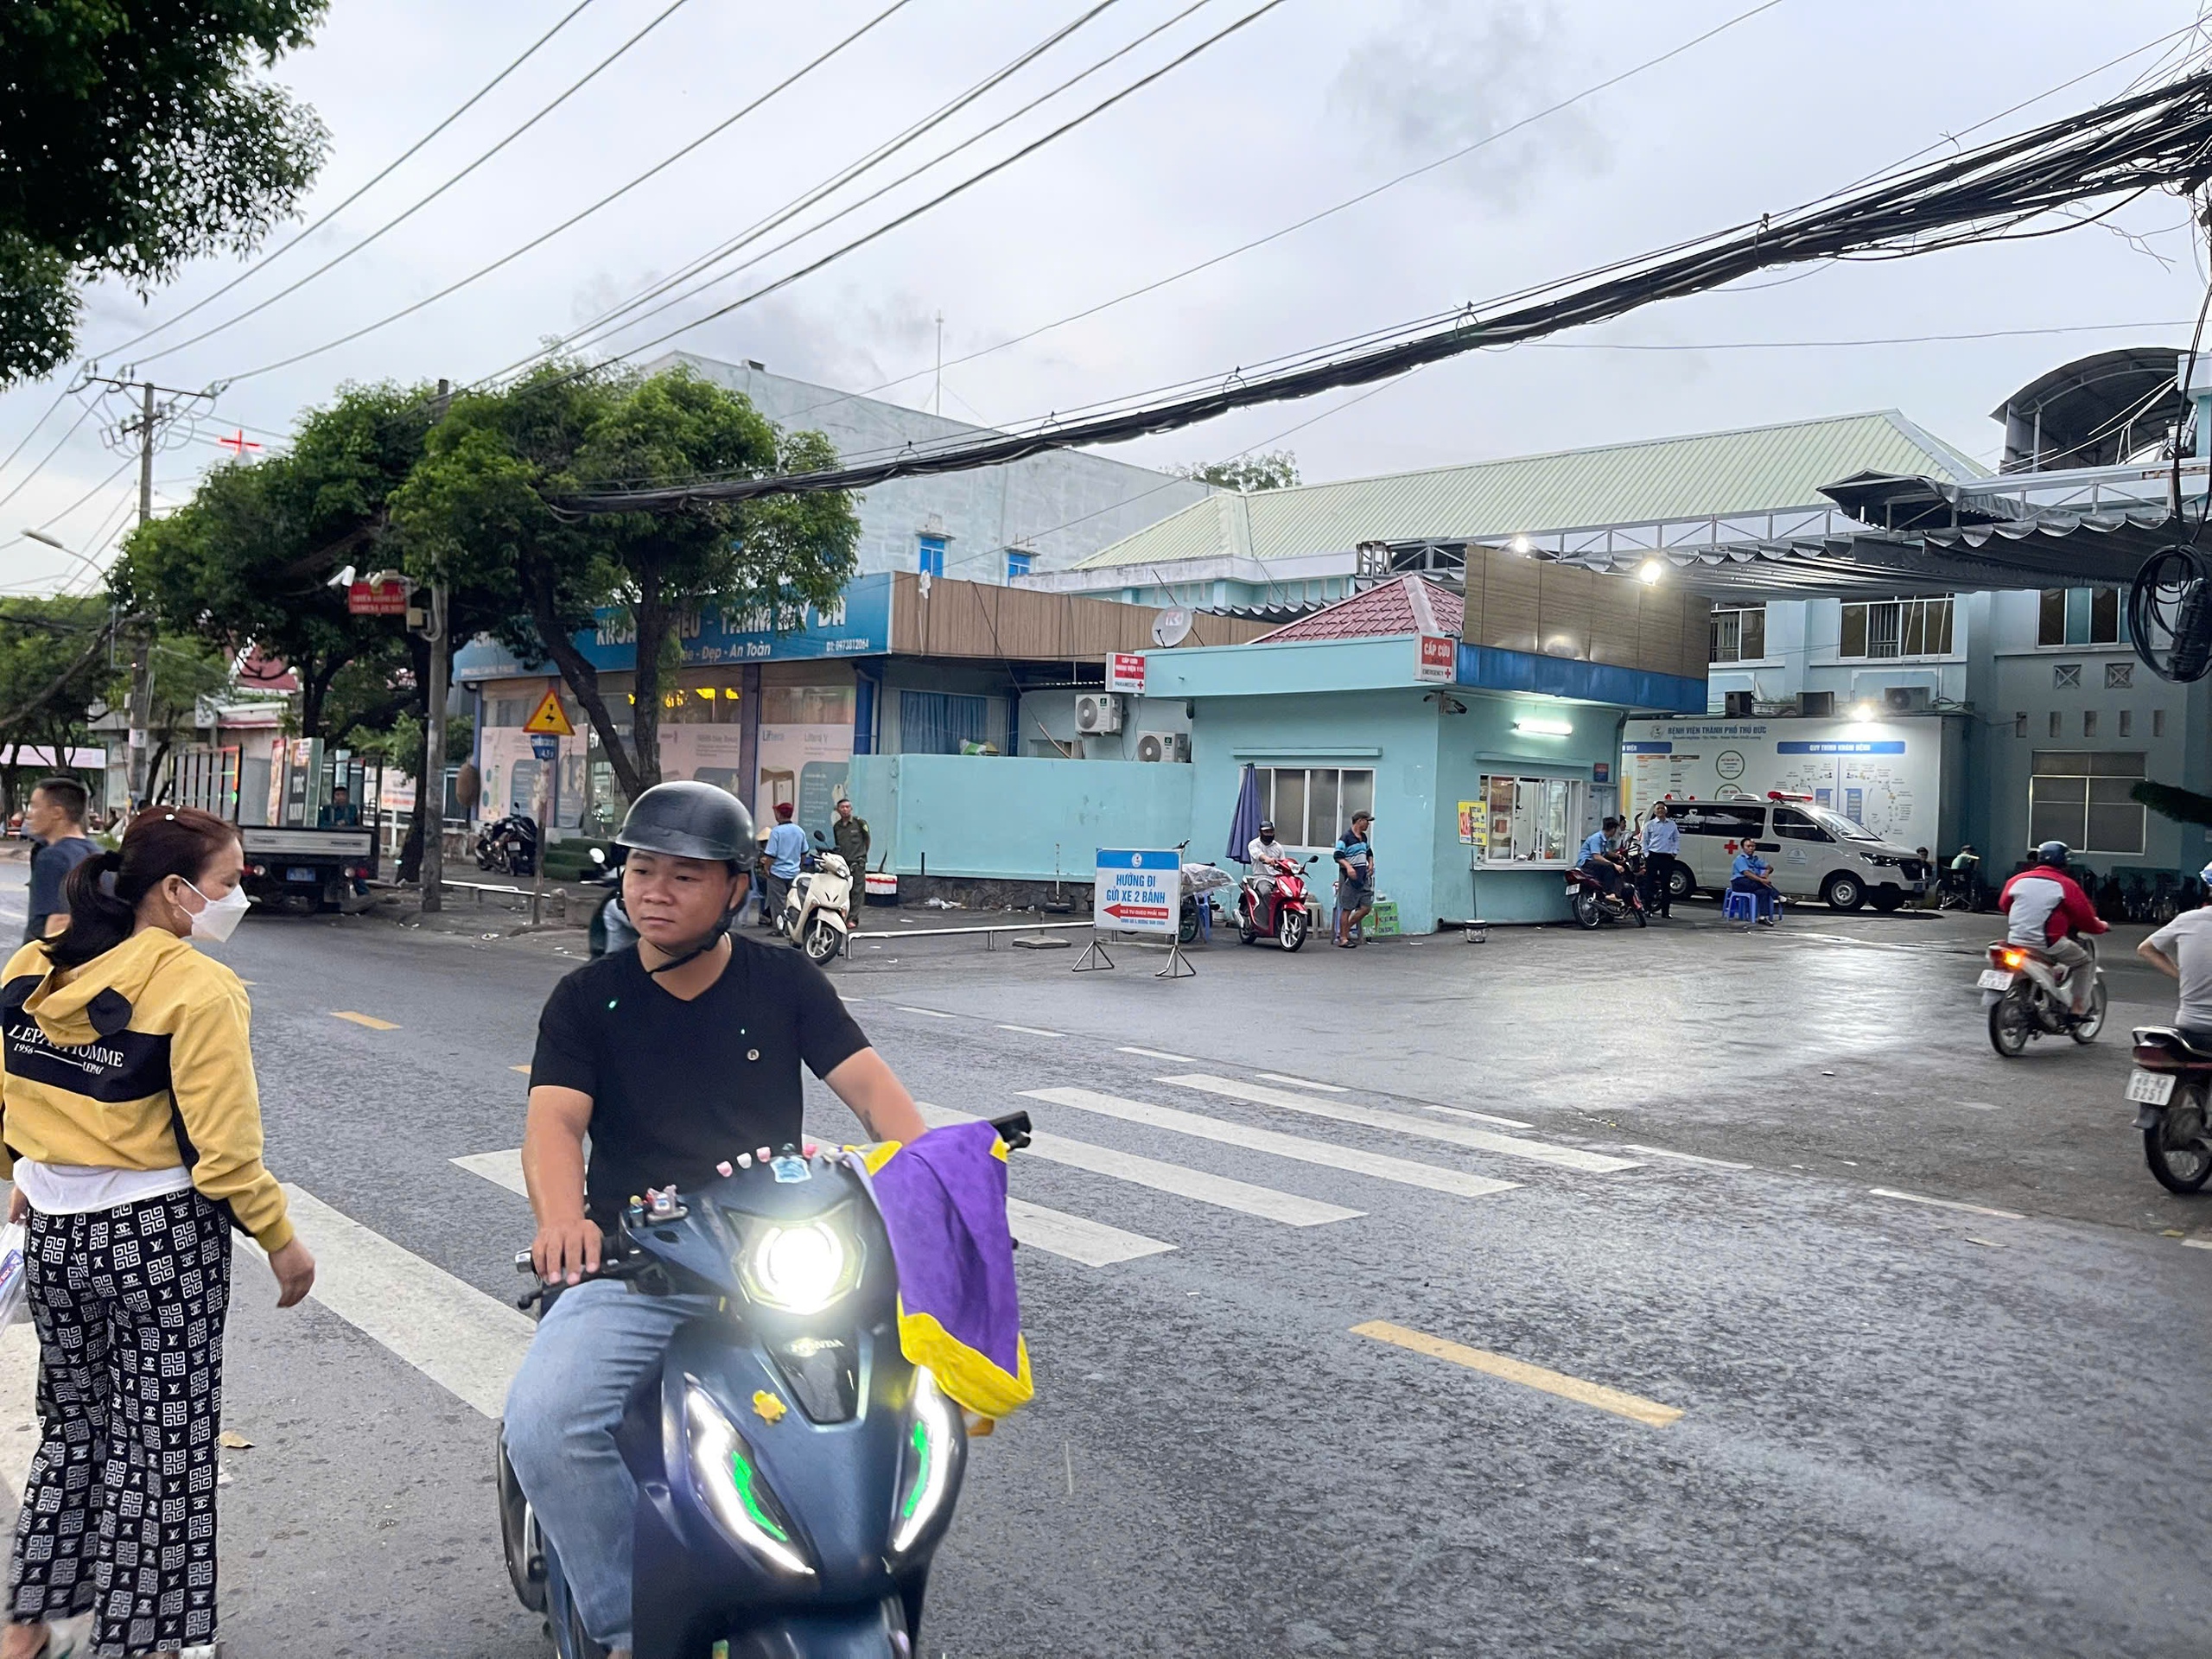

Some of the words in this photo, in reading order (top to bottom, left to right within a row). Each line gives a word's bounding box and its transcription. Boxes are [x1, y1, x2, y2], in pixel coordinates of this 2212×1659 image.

[729, 641, 743, 658] An
[746, 640, 771, 657] Toàn
[1424, 639, 1437, 656] CẤP
[1437, 643, 1451, 658] CỨU
[1686, 726, 1700, 734] VIỆN
[1116, 873, 1145, 887] HƯỚNG
[1147, 875, 1156, 887] ĐI
[1106, 887, 1120, 901] GỬI
[1122, 890, 1132, 902] XE
[1134, 891, 1140, 903] 2
[1141, 889, 1166, 904] BÁNH
[14, 1043, 34, 1054] 1956
